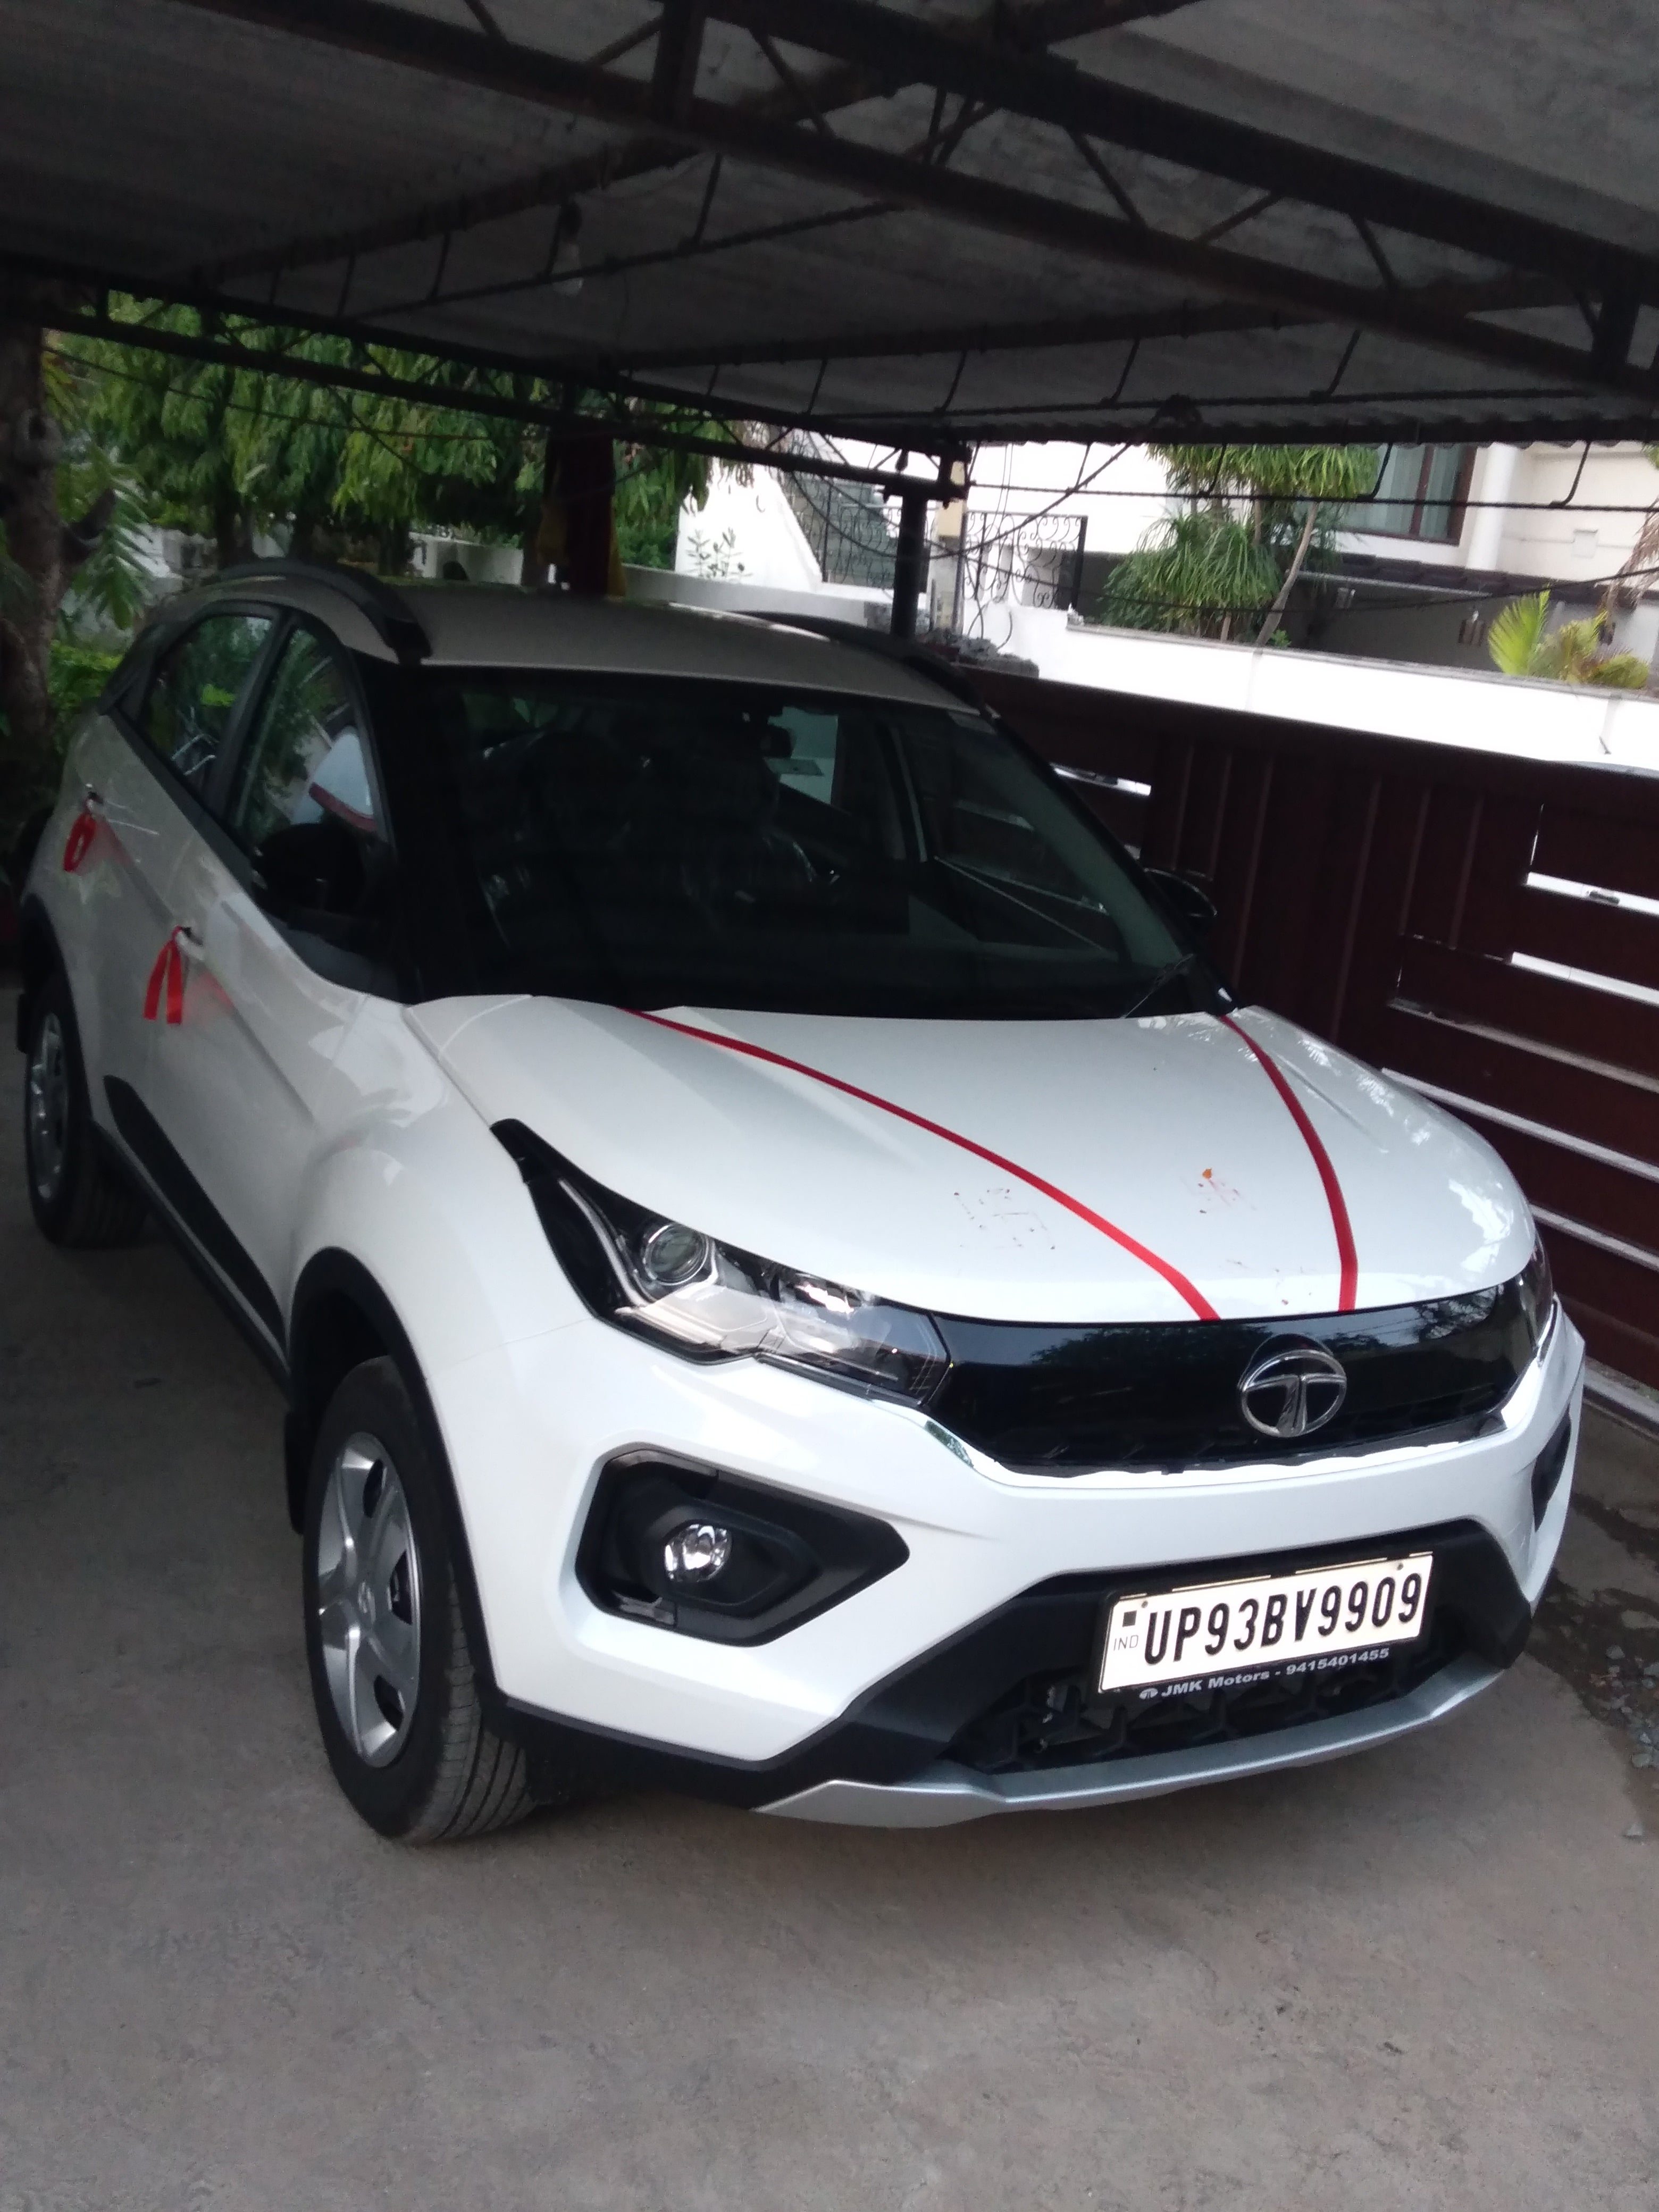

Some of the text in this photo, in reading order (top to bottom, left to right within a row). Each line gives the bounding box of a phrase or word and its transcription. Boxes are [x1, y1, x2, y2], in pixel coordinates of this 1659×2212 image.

[1113, 1634, 1139, 1651] IND
[1144, 1572, 1422, 1665] UP93BV9909
[1161, 1680, 1203, 1697] JMK
[1208, 1671, 1270, 1689] Motors
[1286, 1648, 1389, 1675] 9415401455
